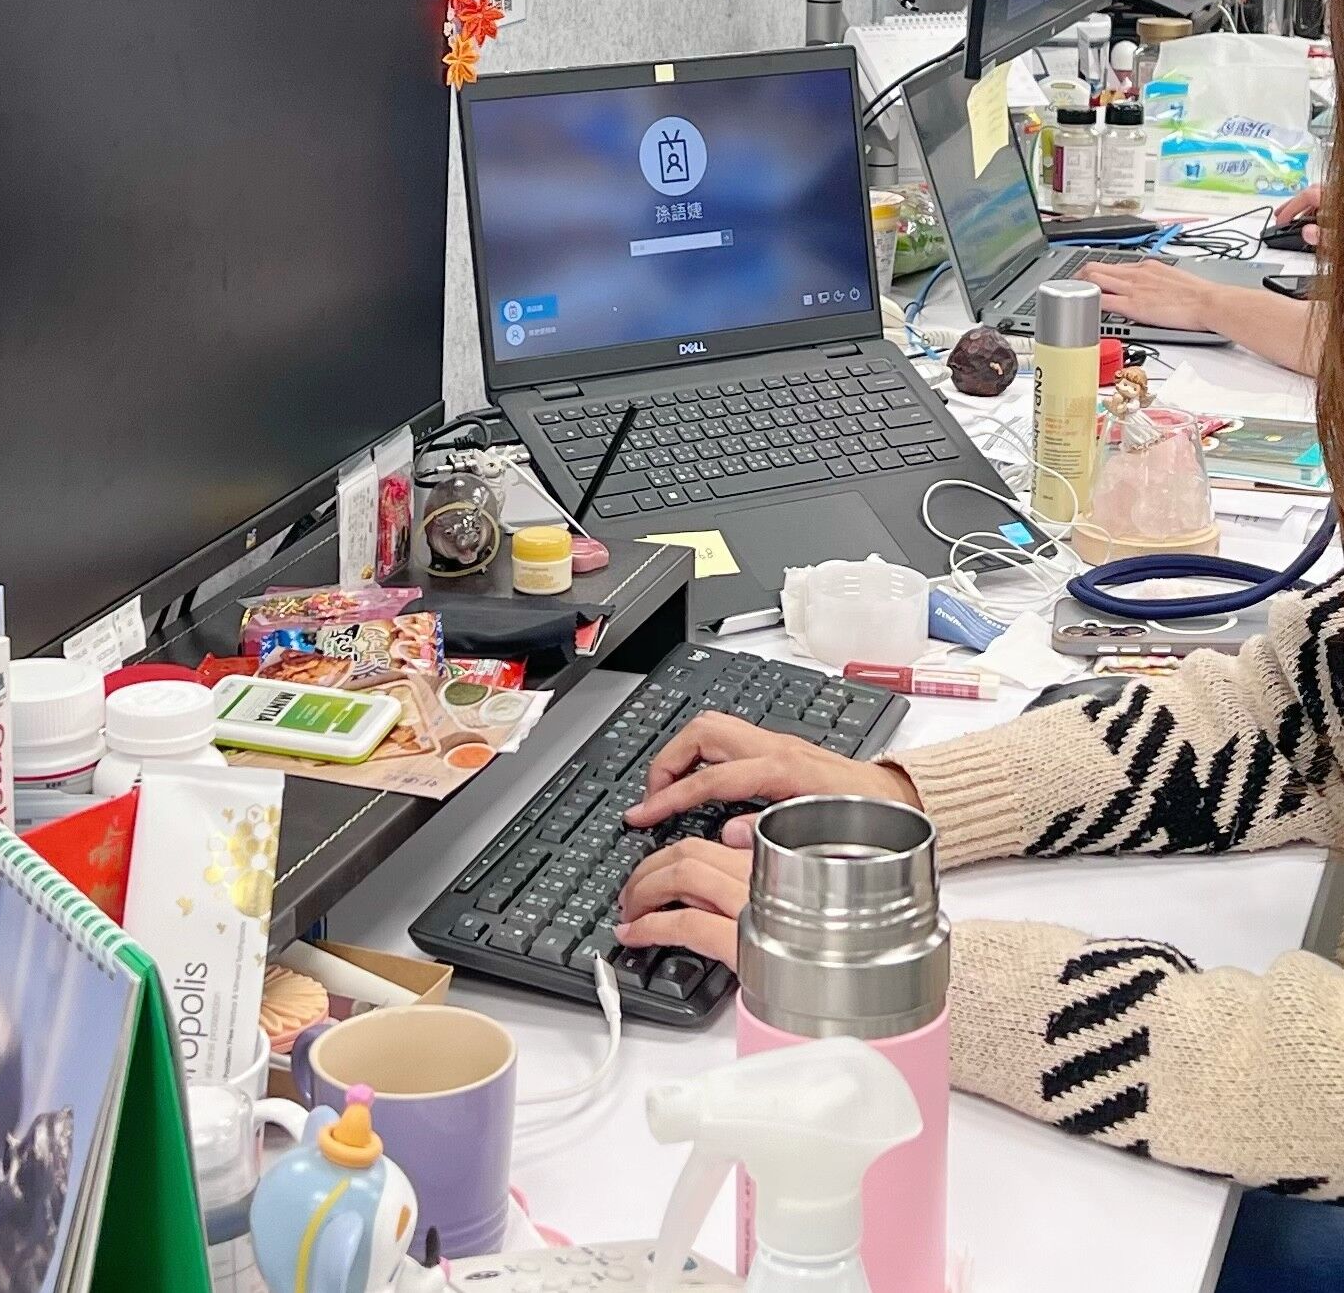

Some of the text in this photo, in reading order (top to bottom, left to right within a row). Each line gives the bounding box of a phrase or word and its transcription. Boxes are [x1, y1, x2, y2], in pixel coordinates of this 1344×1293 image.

[678, 340, 708, 356] DELL
[1033, 365, 1043, 407] CNP
[254, 691, 297, 722] MINTIA
[173, 962, 208, 1080] opolis
